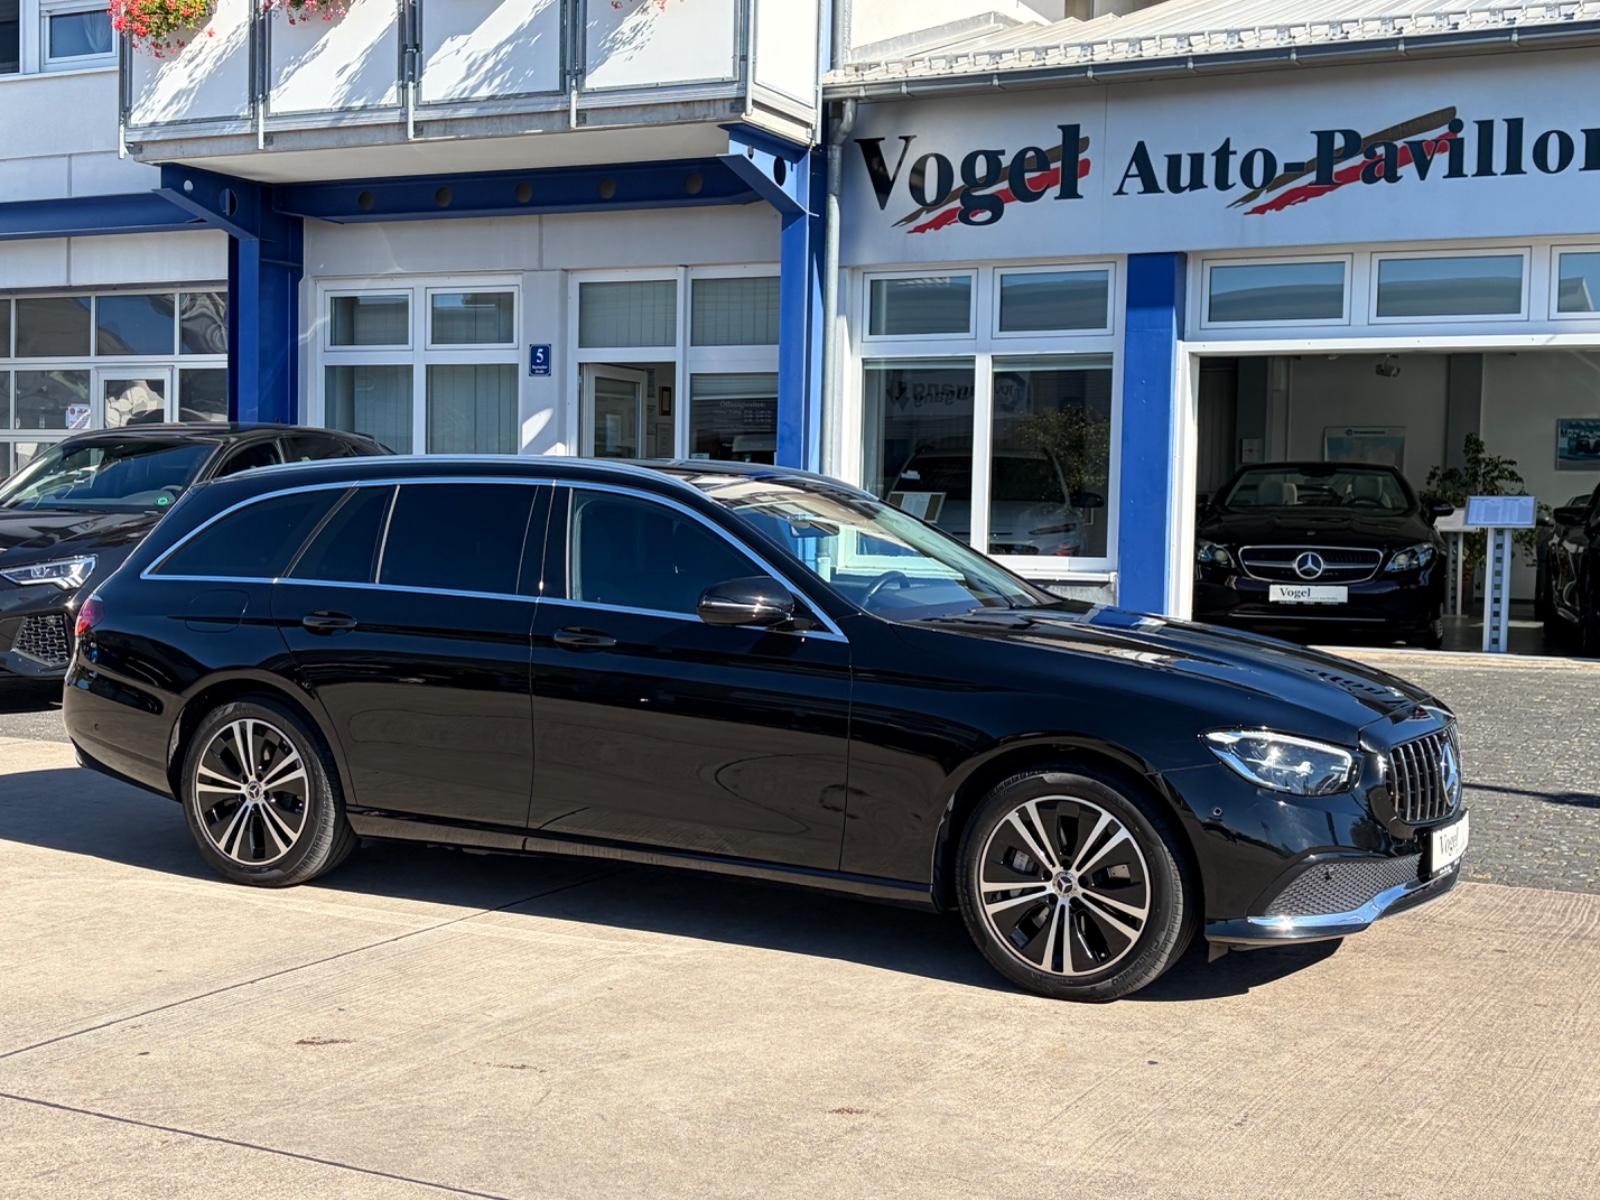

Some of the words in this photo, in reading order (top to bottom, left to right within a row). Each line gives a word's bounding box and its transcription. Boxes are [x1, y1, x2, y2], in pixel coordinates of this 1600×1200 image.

[853, 123, 1082, 226] Vogel
[536, 348, 544, 363] 5
[1280, 587, 1311, 599] Vogel
